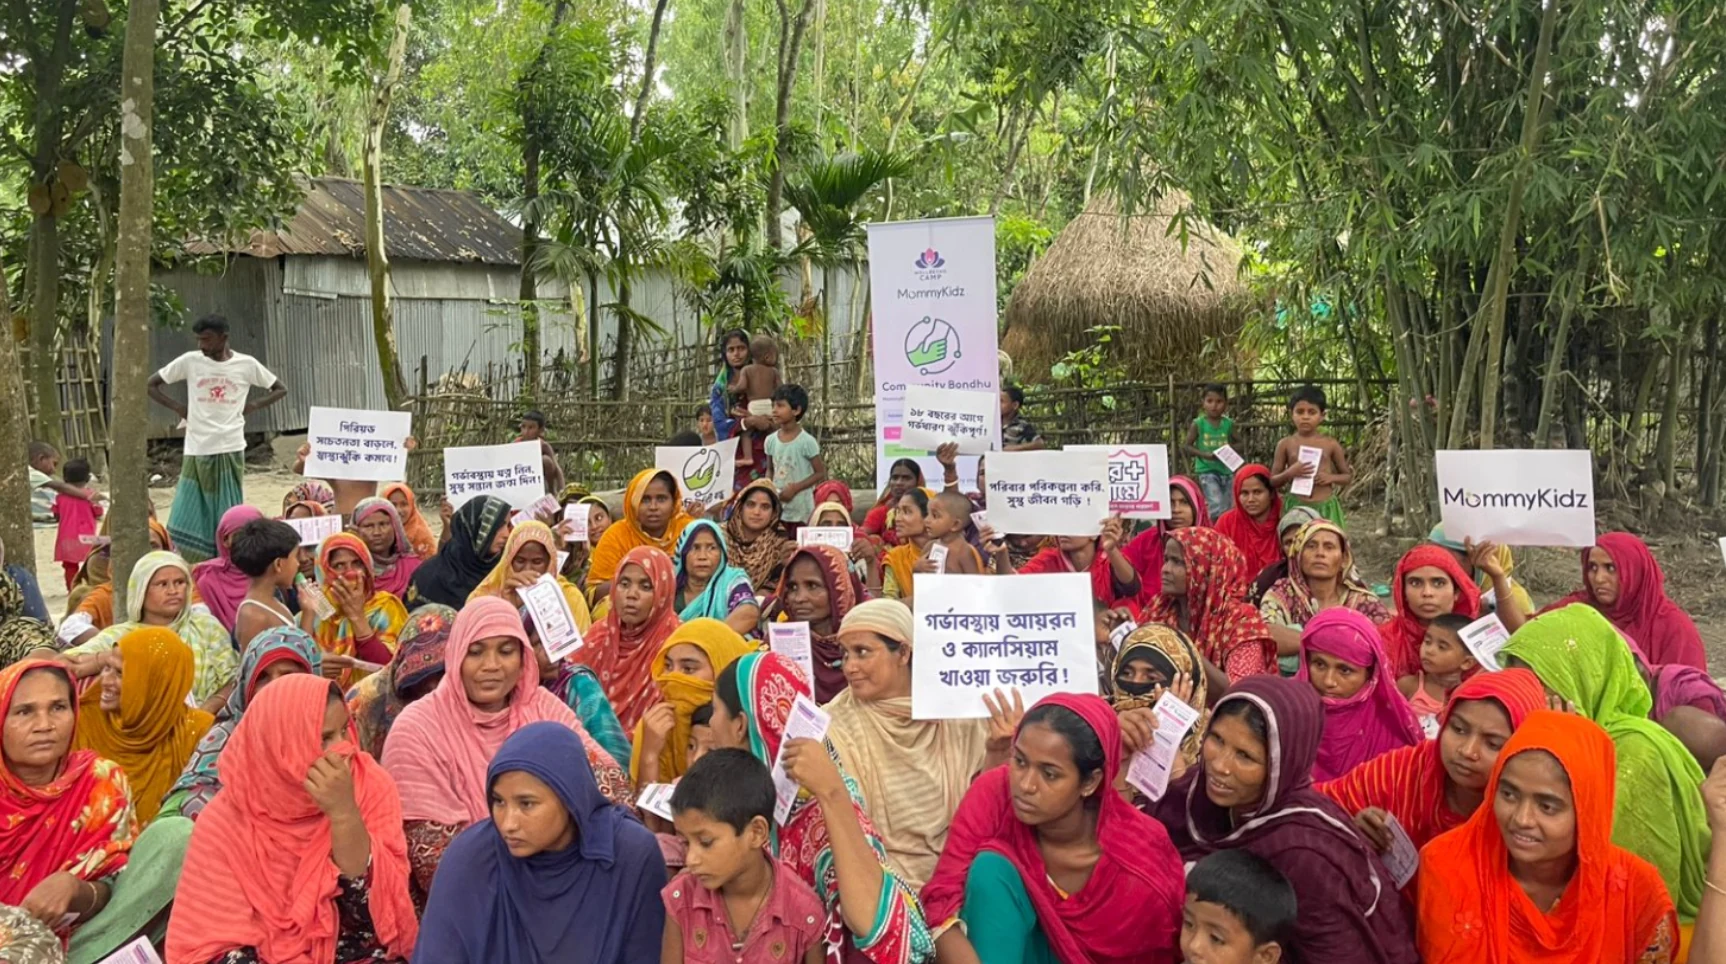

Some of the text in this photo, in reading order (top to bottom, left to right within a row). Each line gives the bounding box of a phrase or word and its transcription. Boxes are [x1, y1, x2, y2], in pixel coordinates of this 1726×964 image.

[897, 286, 965, 300] MommyKidz
[948, 379, 992, 389] Bondhu
[910, 407, 924, 417] ১৮
[927, 409, 957, 421] বছরের
[959, 413, 984, 423] আগে
[339, 420, 376, 434] পিরিয়ড
[908, 418, 945, 432] গর্ভধারণ
[316, 436, 360, 447] সচেতনতা
[989, 480, 1026, 492] পরিবার
[1029, 479, 1077, 493] পরিকল্পনা
[1007, 496, 1024, 509] সুস্থ
[1028, 493, 1058, 505] জীবন
[1443, 487, 1588, 510] MommyKidz
[925, 607, 1076, 634] গর্ভাবস্থায় আয়রন
[942, 635, 1059, 659] ও ক্যালসিয়াম
[939, 669, 991, 688] খাওয়া
